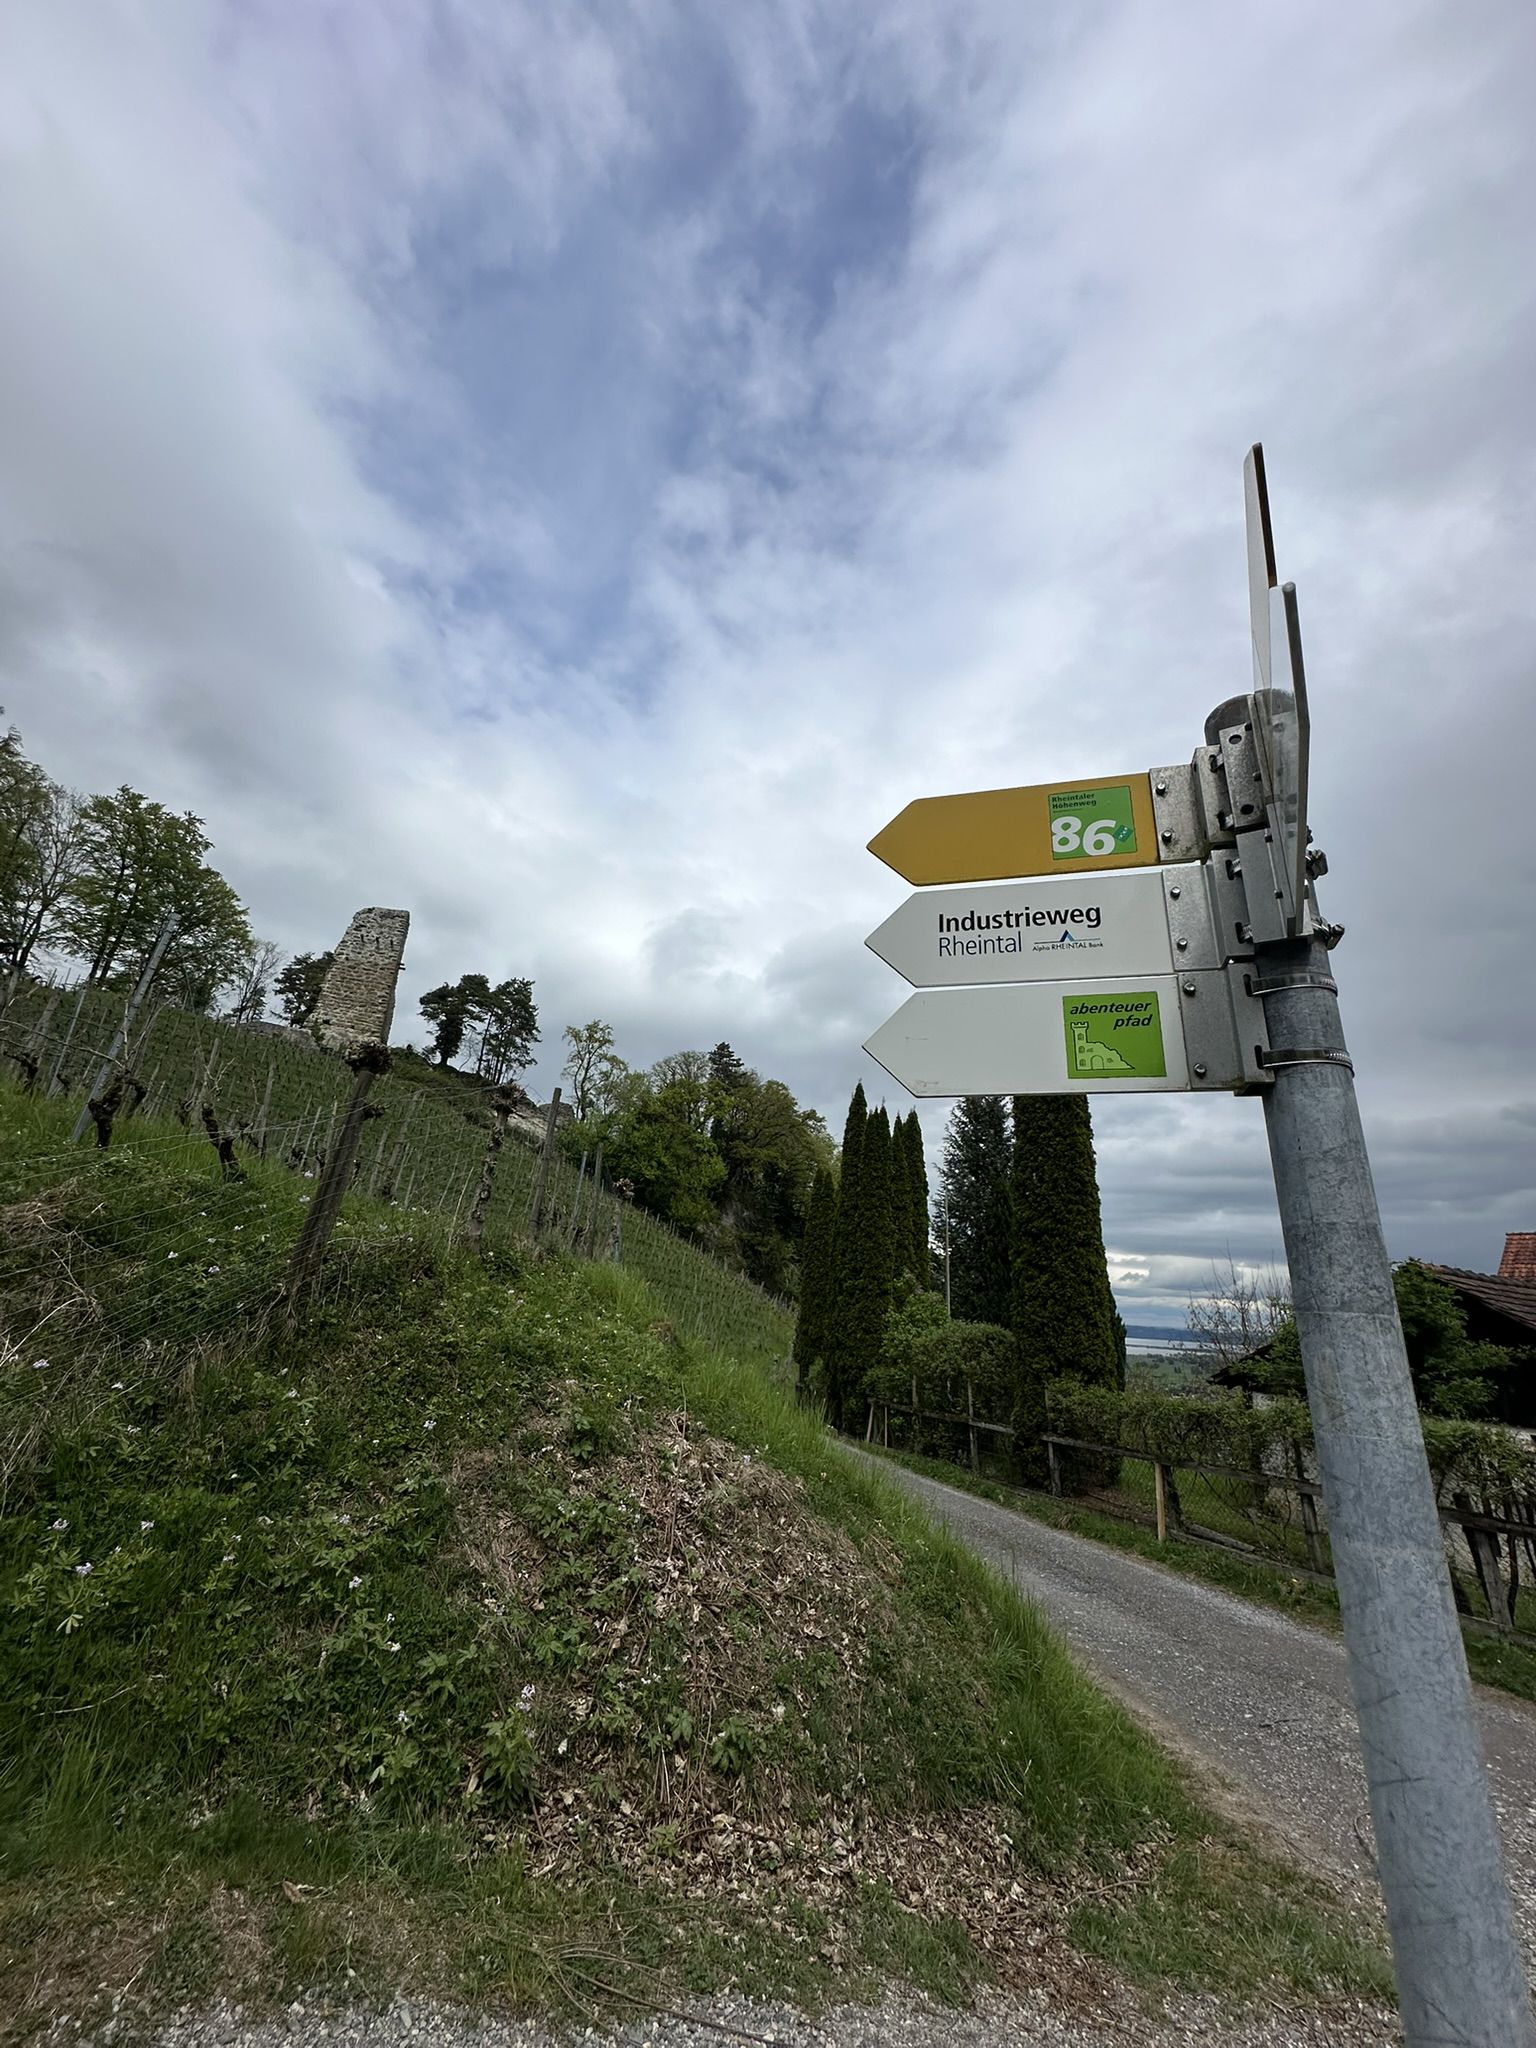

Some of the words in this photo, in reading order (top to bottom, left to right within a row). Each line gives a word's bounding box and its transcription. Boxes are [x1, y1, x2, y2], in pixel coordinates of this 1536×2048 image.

[1052, 793, 1095, 803] Rheintaler
[1052, 799, 1097, 809] Höhenweg
[1051, 816, 1117, 857] 86
[938, 906, 1102, 933] Industrieweg
[939, 931, 1022, 957] Rheintal
[1032, 945, 1051, 953] Alpha
[1051, 942, 1088, 951] RHEINTAL
[1069, 1001, 1152, 1015] abenteuer
[1113, 1013, 1153, 1031] pfad
